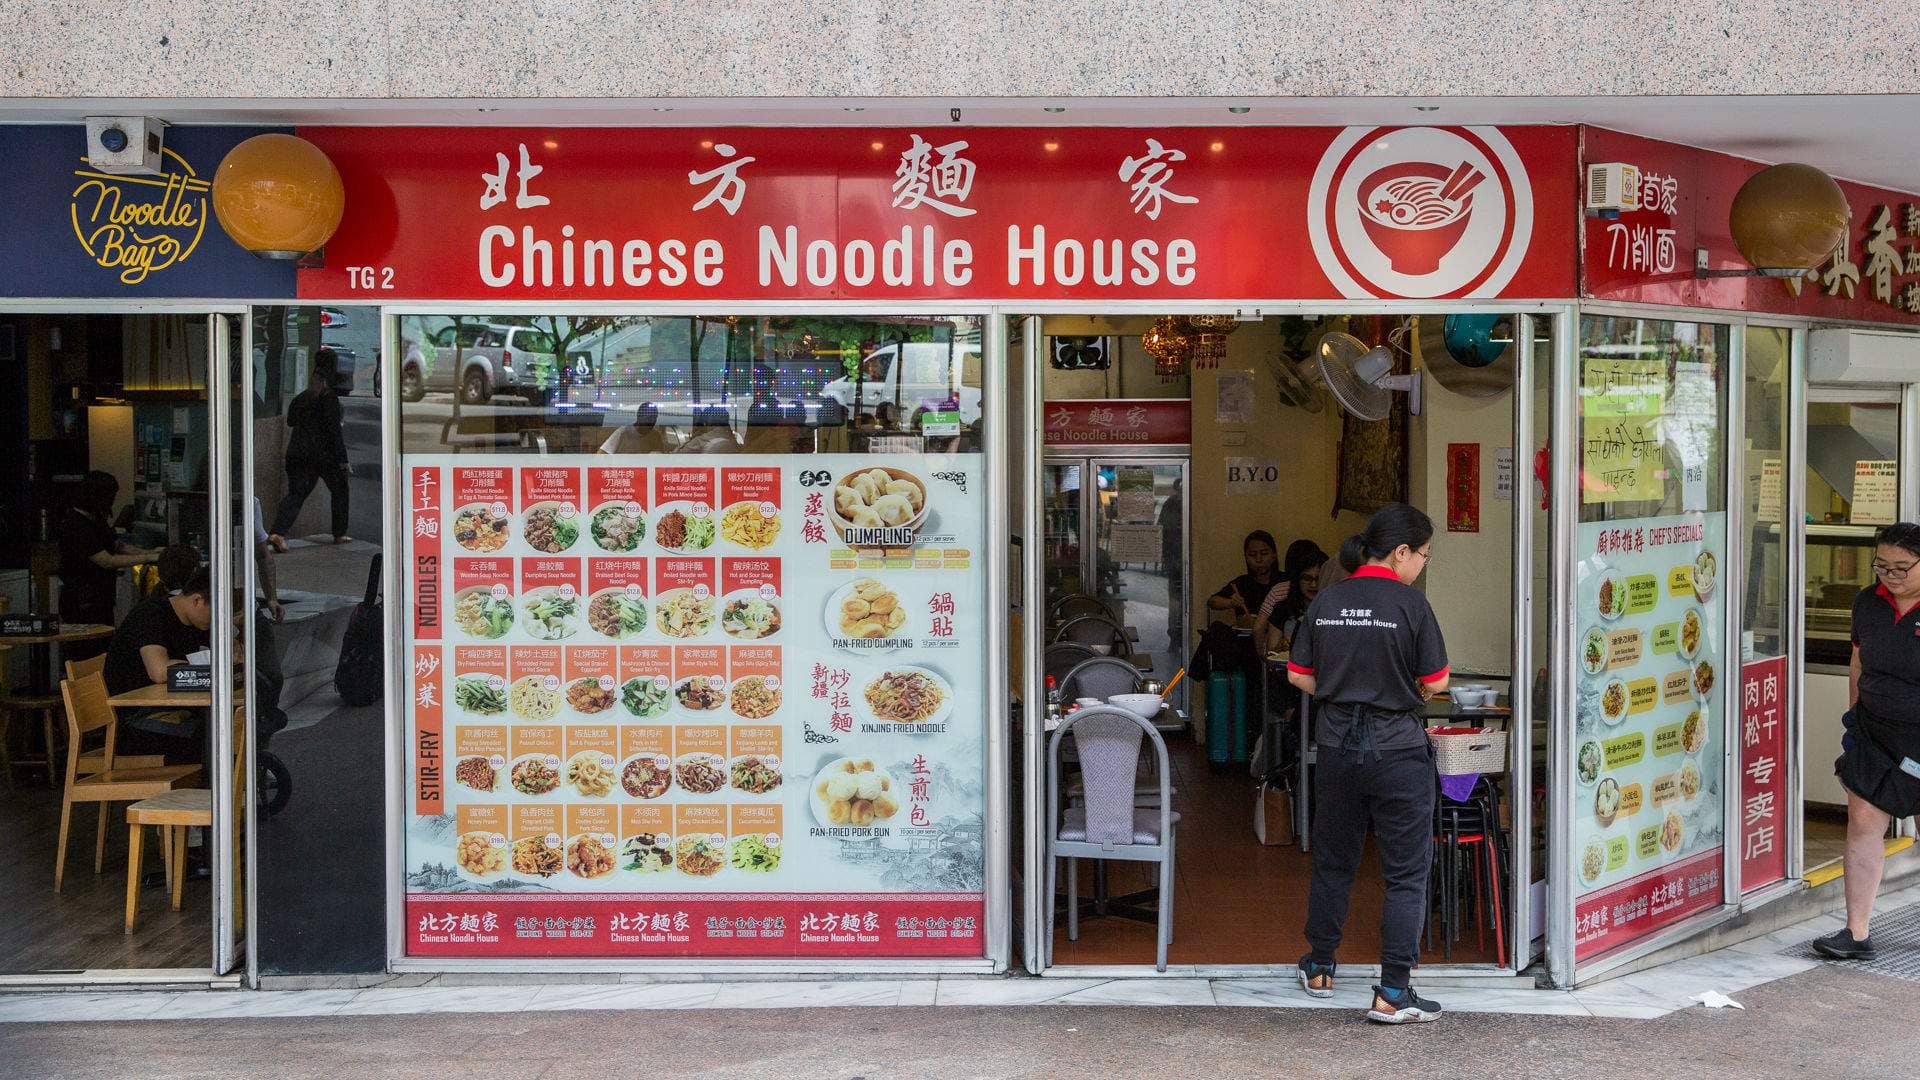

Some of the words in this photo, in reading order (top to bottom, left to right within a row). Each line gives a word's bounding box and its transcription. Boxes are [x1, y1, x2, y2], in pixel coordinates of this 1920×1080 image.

[73, 174, 198, 226] Noodle
[90, 225, 180, 284] Bay
[479, 225, 725, 287] Chinese
[758, 224, 974, 287] Noodle
[1008, 224, 1197, 286] House
[1606, 223, 1677, 273] 刀削面
[346, 266, 375, 290] TG
[381, 266, 395, 290] 2
[1064, 429, 1107, 440] Noodle
[1110, 429, 1149, 440] House
[413, 470, 440, 538] 手工麵
[845, 528, 912, 544] DUMPLING
[1649, 528, 1672, 546] CHEF'S
[418, 556, 437, 627] NOODLES
[928, 592, 955, 637] 鍋貼
[1315, 618, 1344, 626] Chinese
[1345, 618, 1372, 626] Noodle
[1373, 619, 1397, 629] House
[833, 638, 873, 649] PAN-FRIED
[873, 638, 913, 649] DUMPLING
[415, 653, 440, 709] 炒菜
[861, 723, 892, 733] XINJING
[893, 723, 915, 733] FRIED
[916, 723, 946, 733] NOODLE
[420, 730, 439, 801] STIR-FRY
[908, 753, 931, 827] 生煎包
[1744, 756, 1776, 861] 专卖店
[810, 827, 850, 837] PAN-FRIED
[851, 827, 872, 837] PORK
[873, 827, 890, 837] BUN
[419, 911, 499, 933] 北方麵家
[610, 911, 690, 933] 北方麵家
[799, 911, 879, 933] 北方麵家
[420, 933, 448, 943] Chinese
[450, 933, 475, 943] Noodle
[476, 933, 499, 943] House
[611, 933, 639, 943] Chinese
[641, 933, 666, 943] Noodle
[667, 933, 690, 943] House
[800, 933, 829, 943] Chinese
[831, 933, 855, 943] Noodle
[857, 933, 880, 943] House
